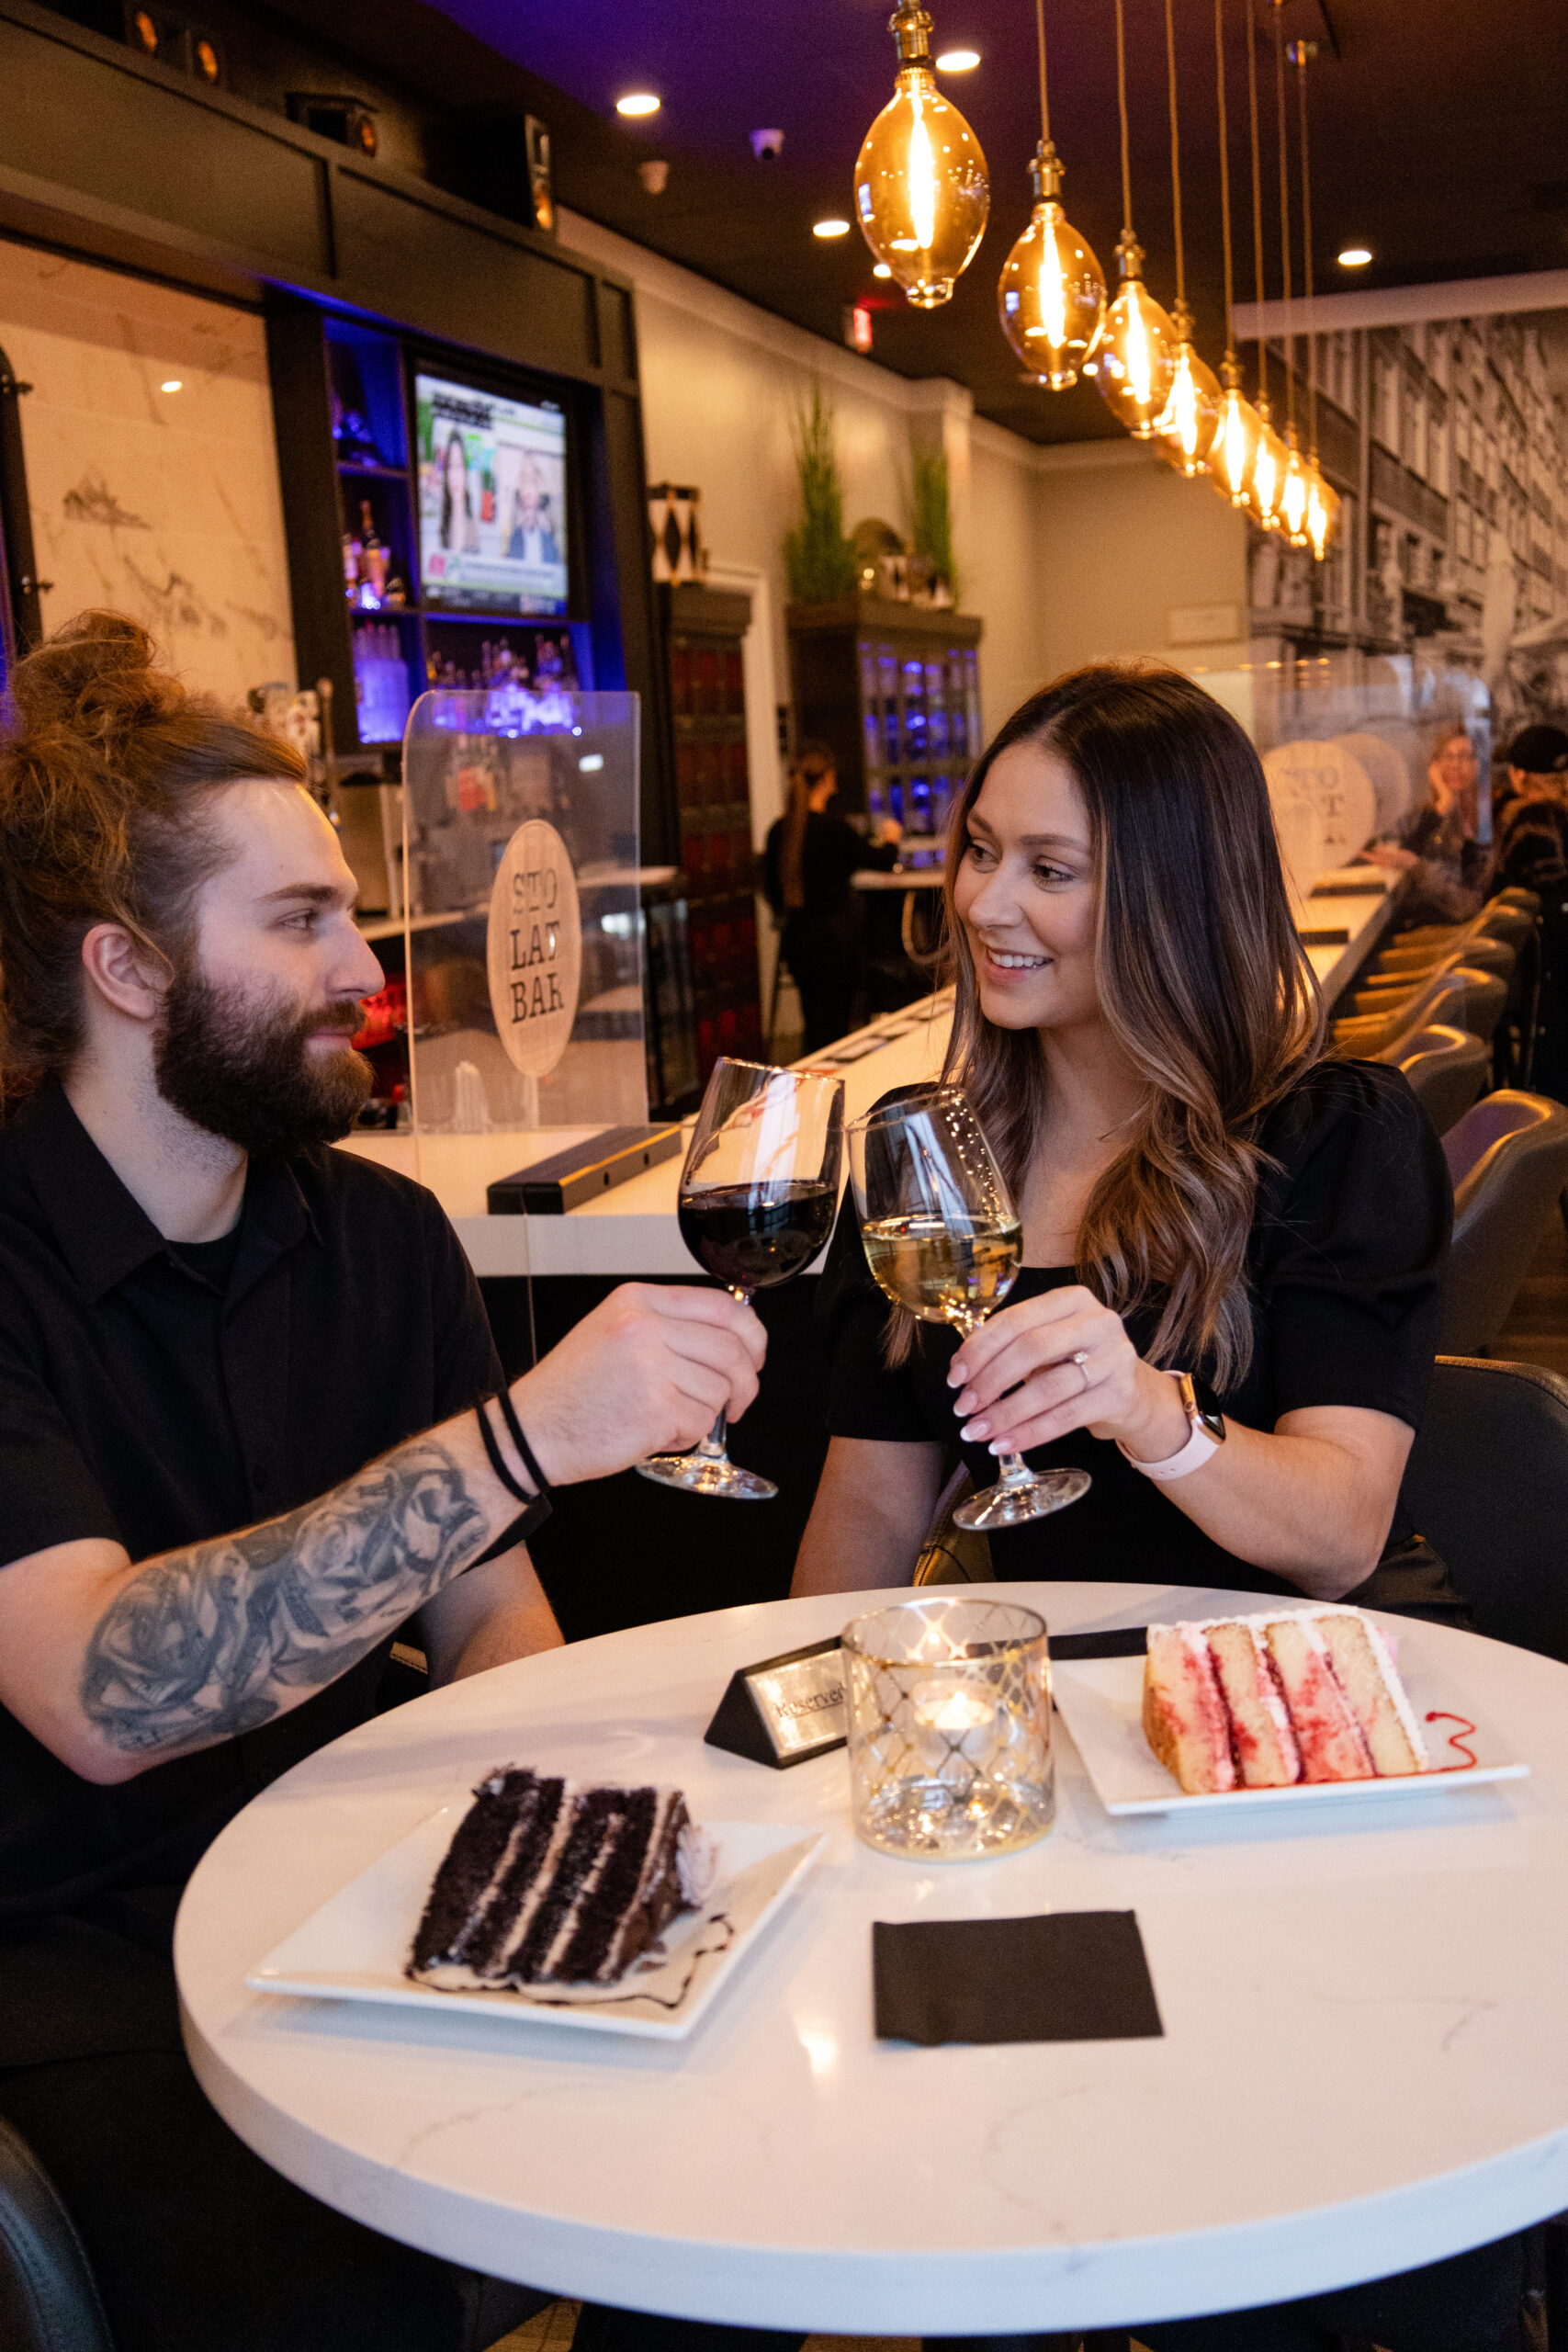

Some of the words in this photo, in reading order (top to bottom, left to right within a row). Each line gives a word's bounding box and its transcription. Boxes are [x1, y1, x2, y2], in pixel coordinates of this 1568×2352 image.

[512, 867, 558, 916] STO
[510, 920, 561, 971] LAT
[510, 971, 565, 1024] BAR
